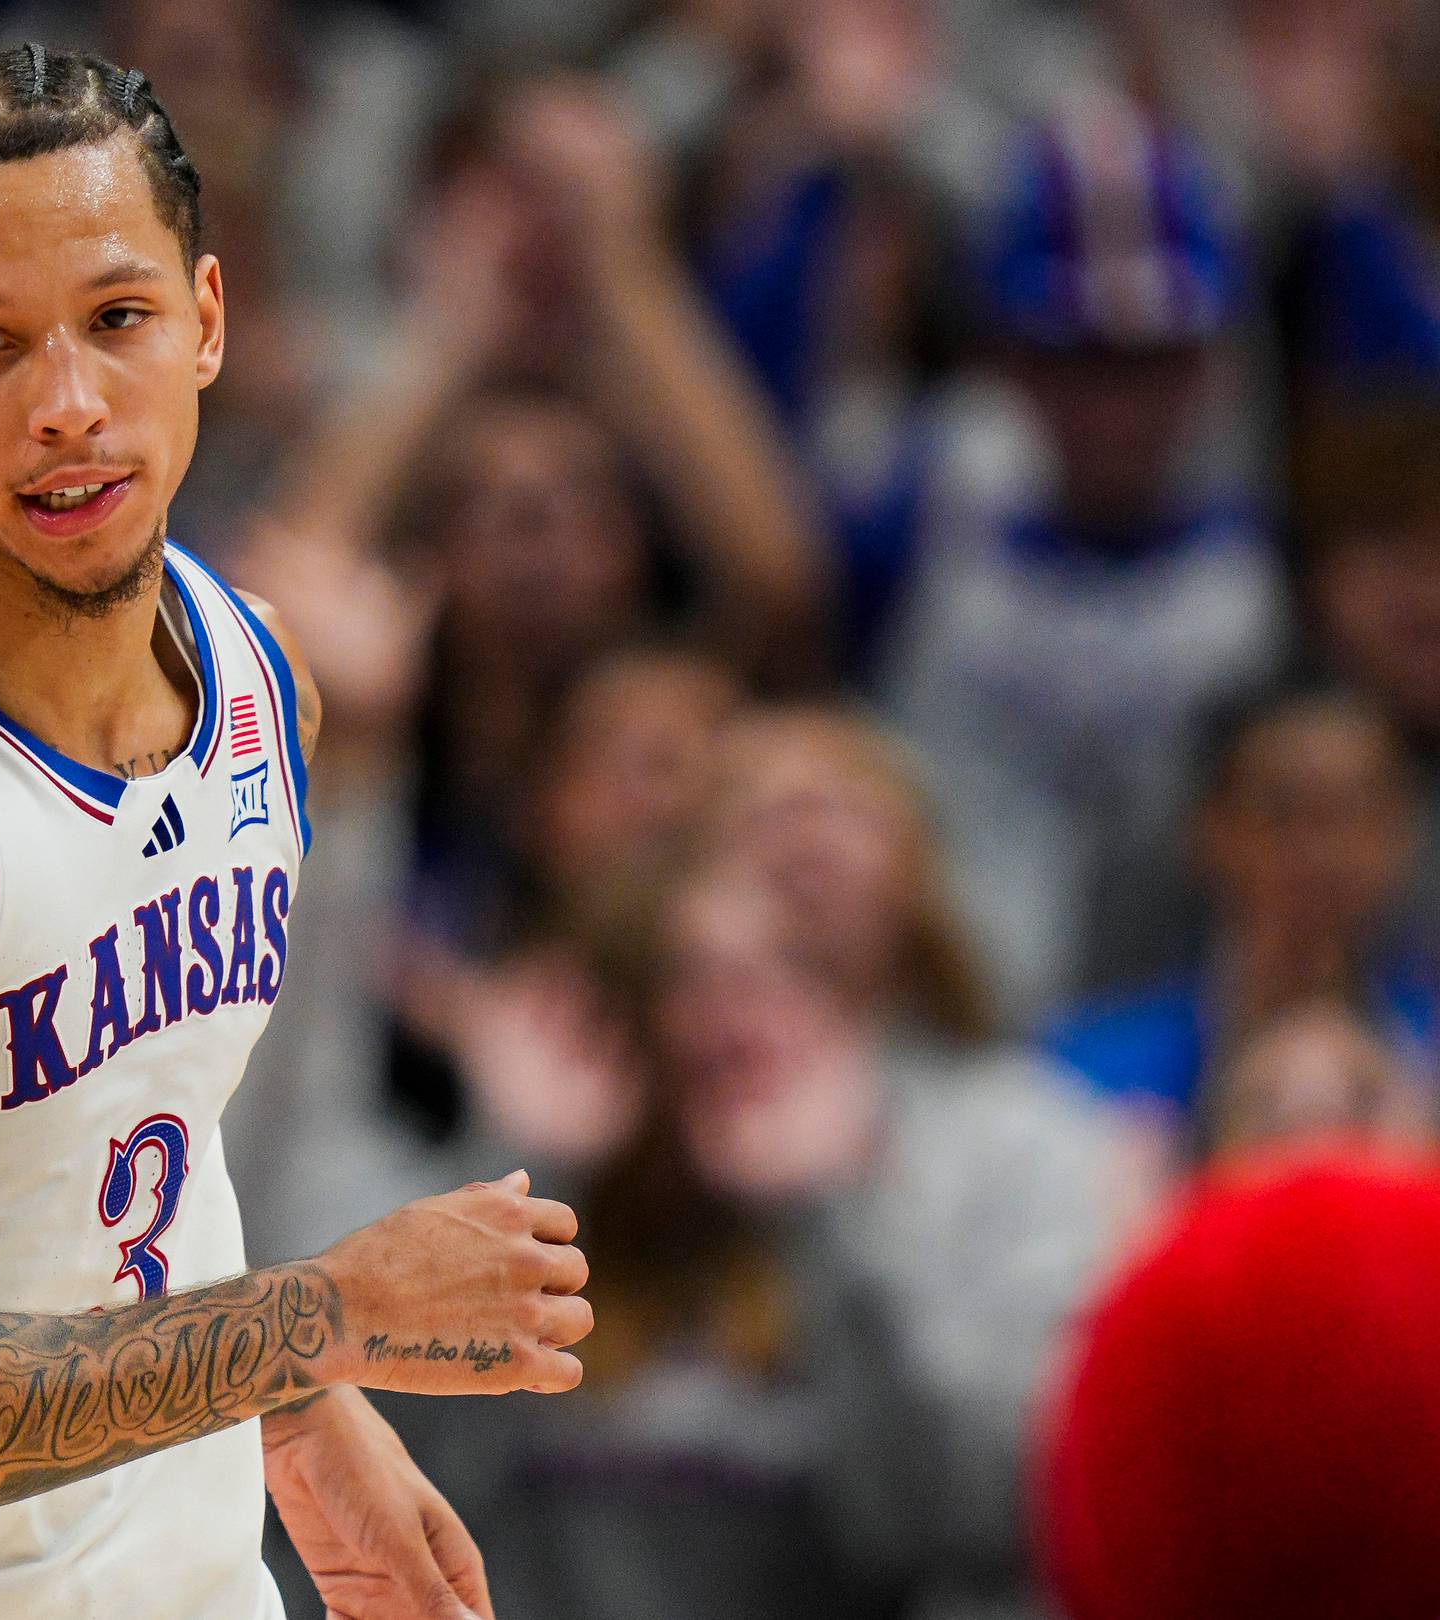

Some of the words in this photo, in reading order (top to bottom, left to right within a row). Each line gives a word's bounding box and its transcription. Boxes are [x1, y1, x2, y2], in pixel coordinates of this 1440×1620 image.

[98, 1113, 189, 1302] 3
[425, 1338, 458, 1361] too
[462, 1338, 513, 1373] high
